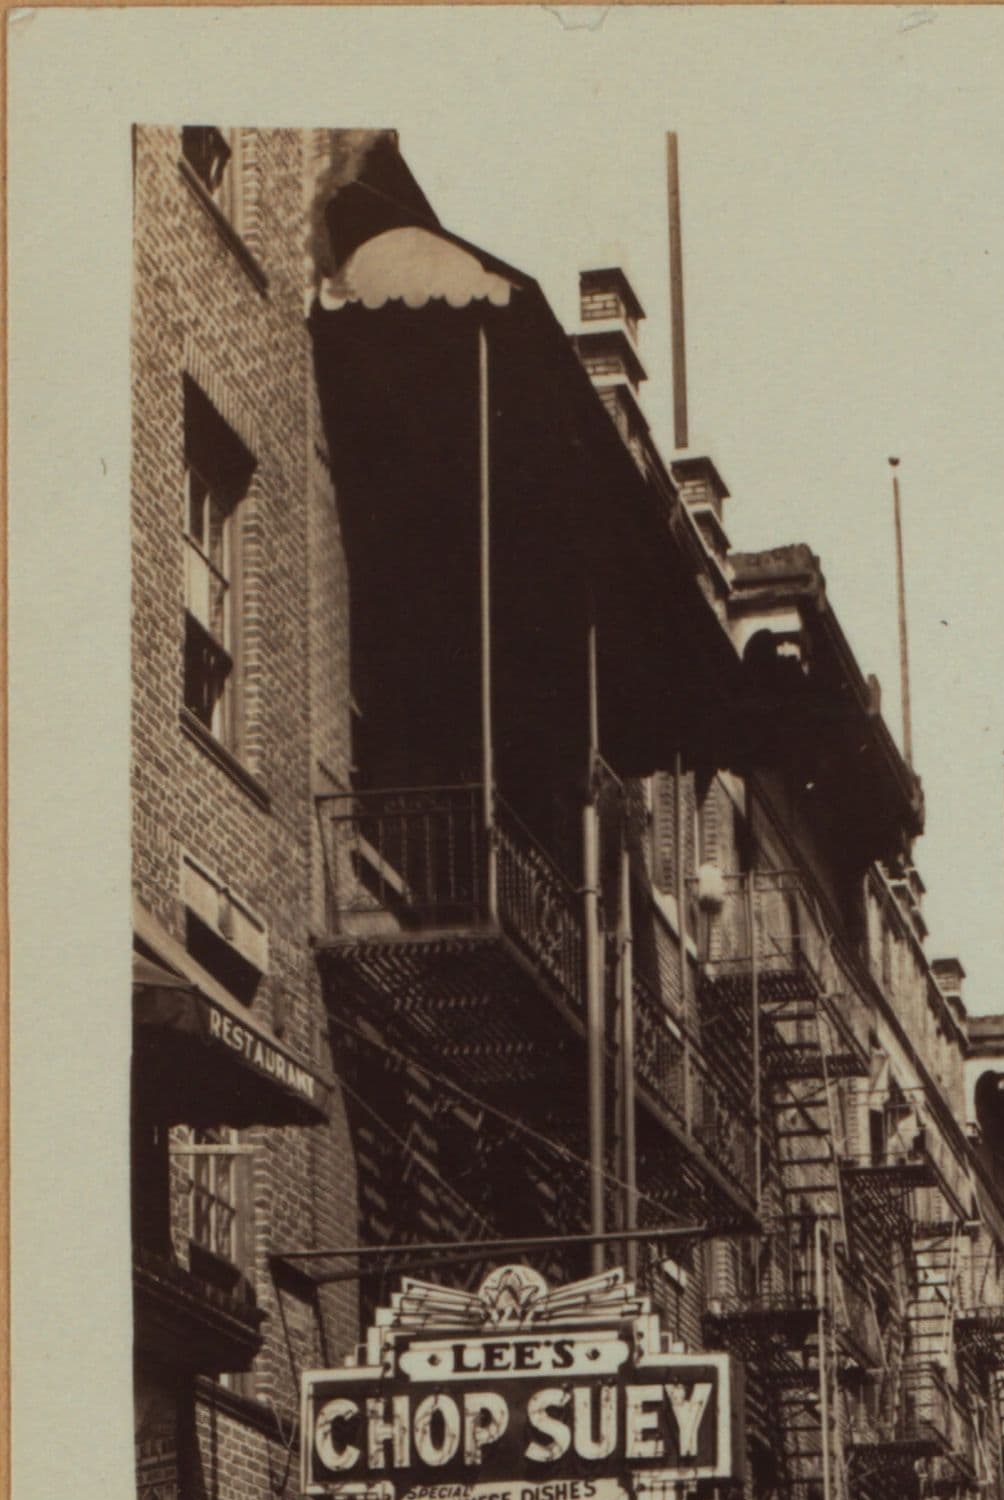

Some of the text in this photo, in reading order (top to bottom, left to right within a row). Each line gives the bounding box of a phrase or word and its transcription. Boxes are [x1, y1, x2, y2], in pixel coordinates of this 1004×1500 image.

[210, 1008, 315, 1099] RESTAURANT
[452, 1339, 577, 1373] LEE'S
[315, 1392, 510, 1472] CHOP
[524, 1381, 713, 1463] SUEY
[406, 1484, 473, 1500] SPECIAL
